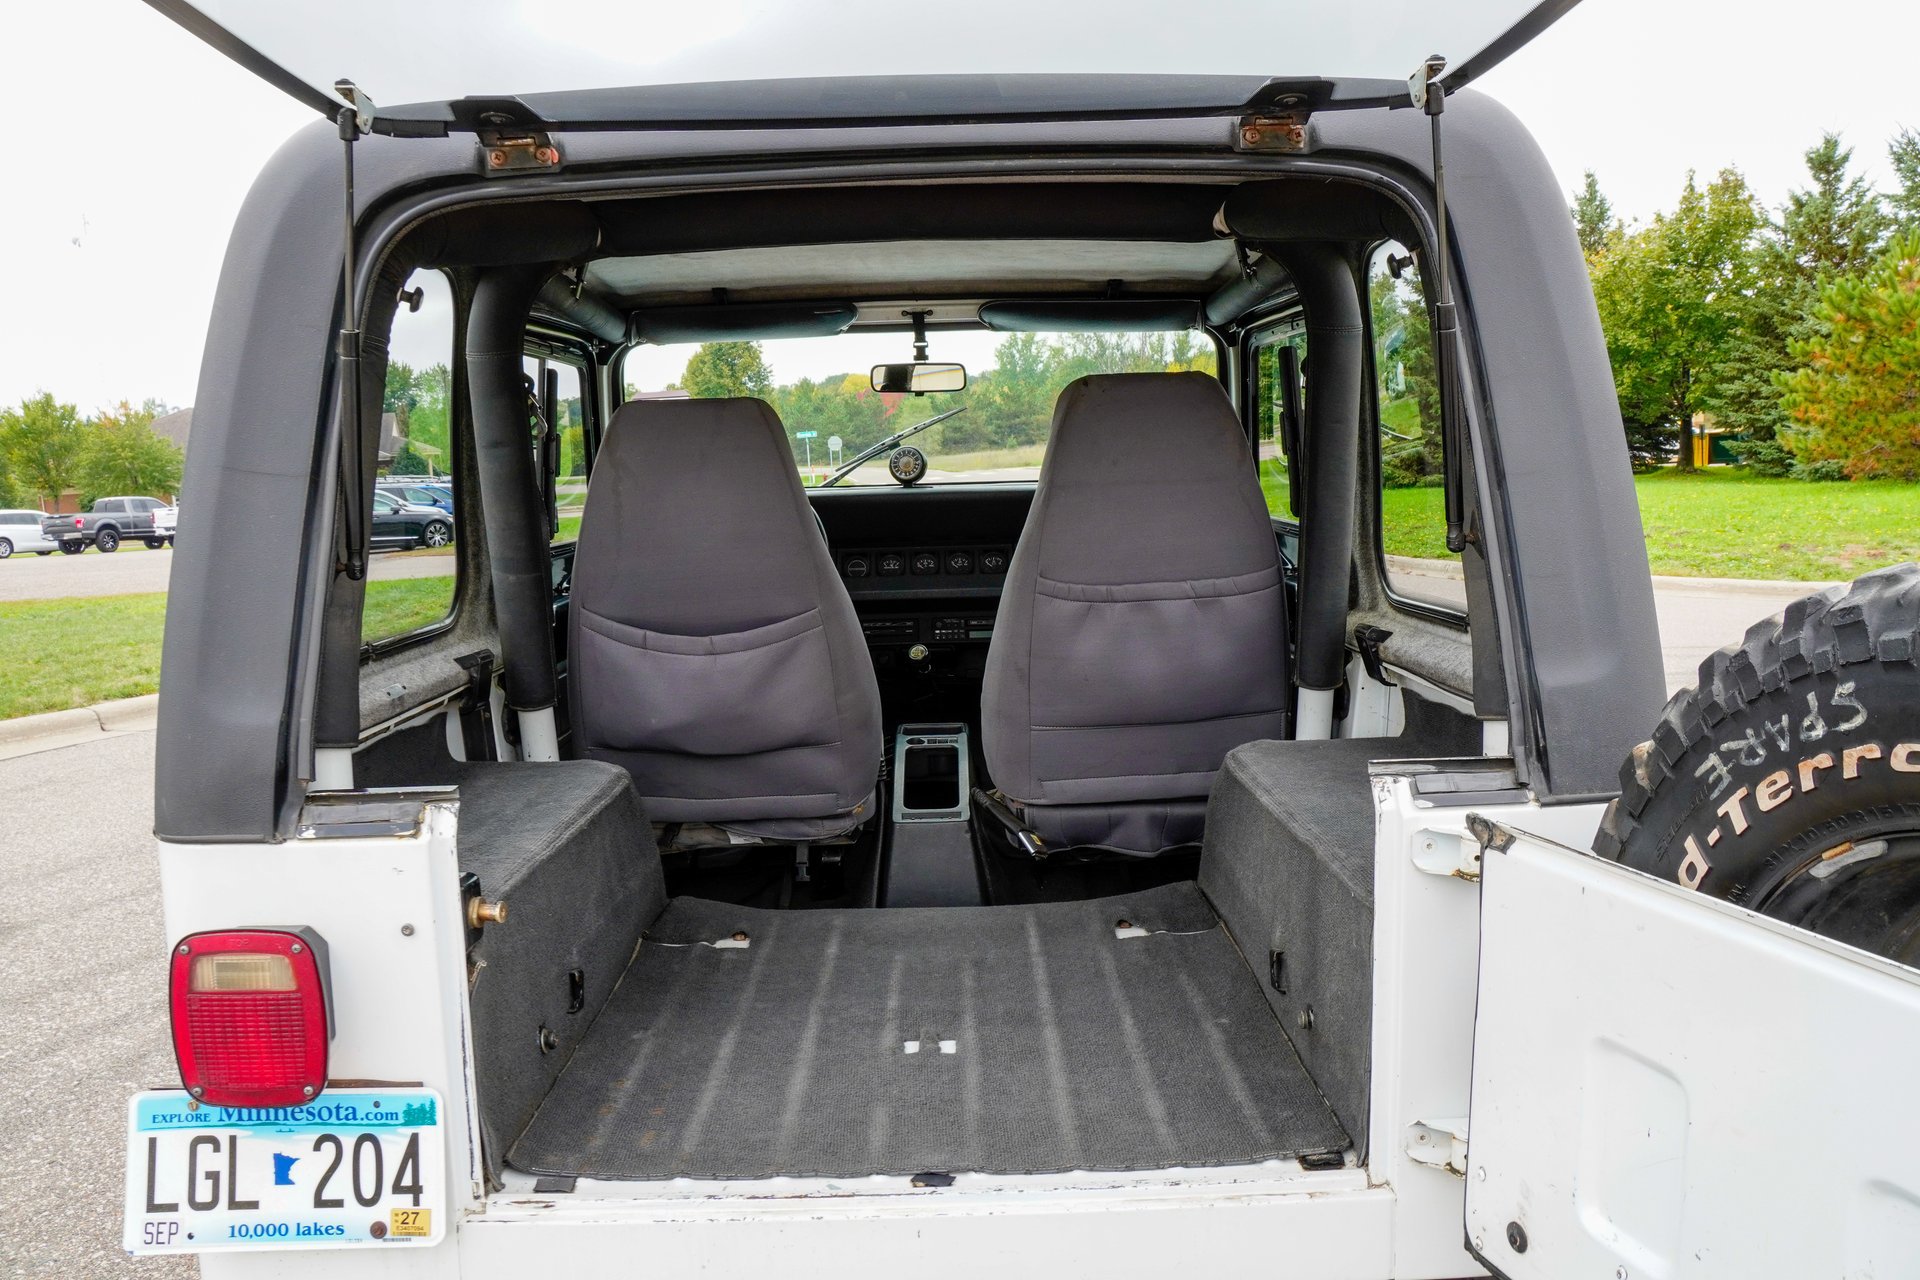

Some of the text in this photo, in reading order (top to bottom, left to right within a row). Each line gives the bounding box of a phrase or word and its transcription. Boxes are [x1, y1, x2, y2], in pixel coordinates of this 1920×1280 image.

[1693, 680, 1868, 801] SPARE
[152, 1102, 399, 1124] EXPLORE Minnesota.com
[145, 1132, 424, 1213] LGL 204
[400, 1211, 420, 1225] 27
[144, 1221, 179, 1245] SEP
[228, 1221, 345, 1239] 10,000 lakes
